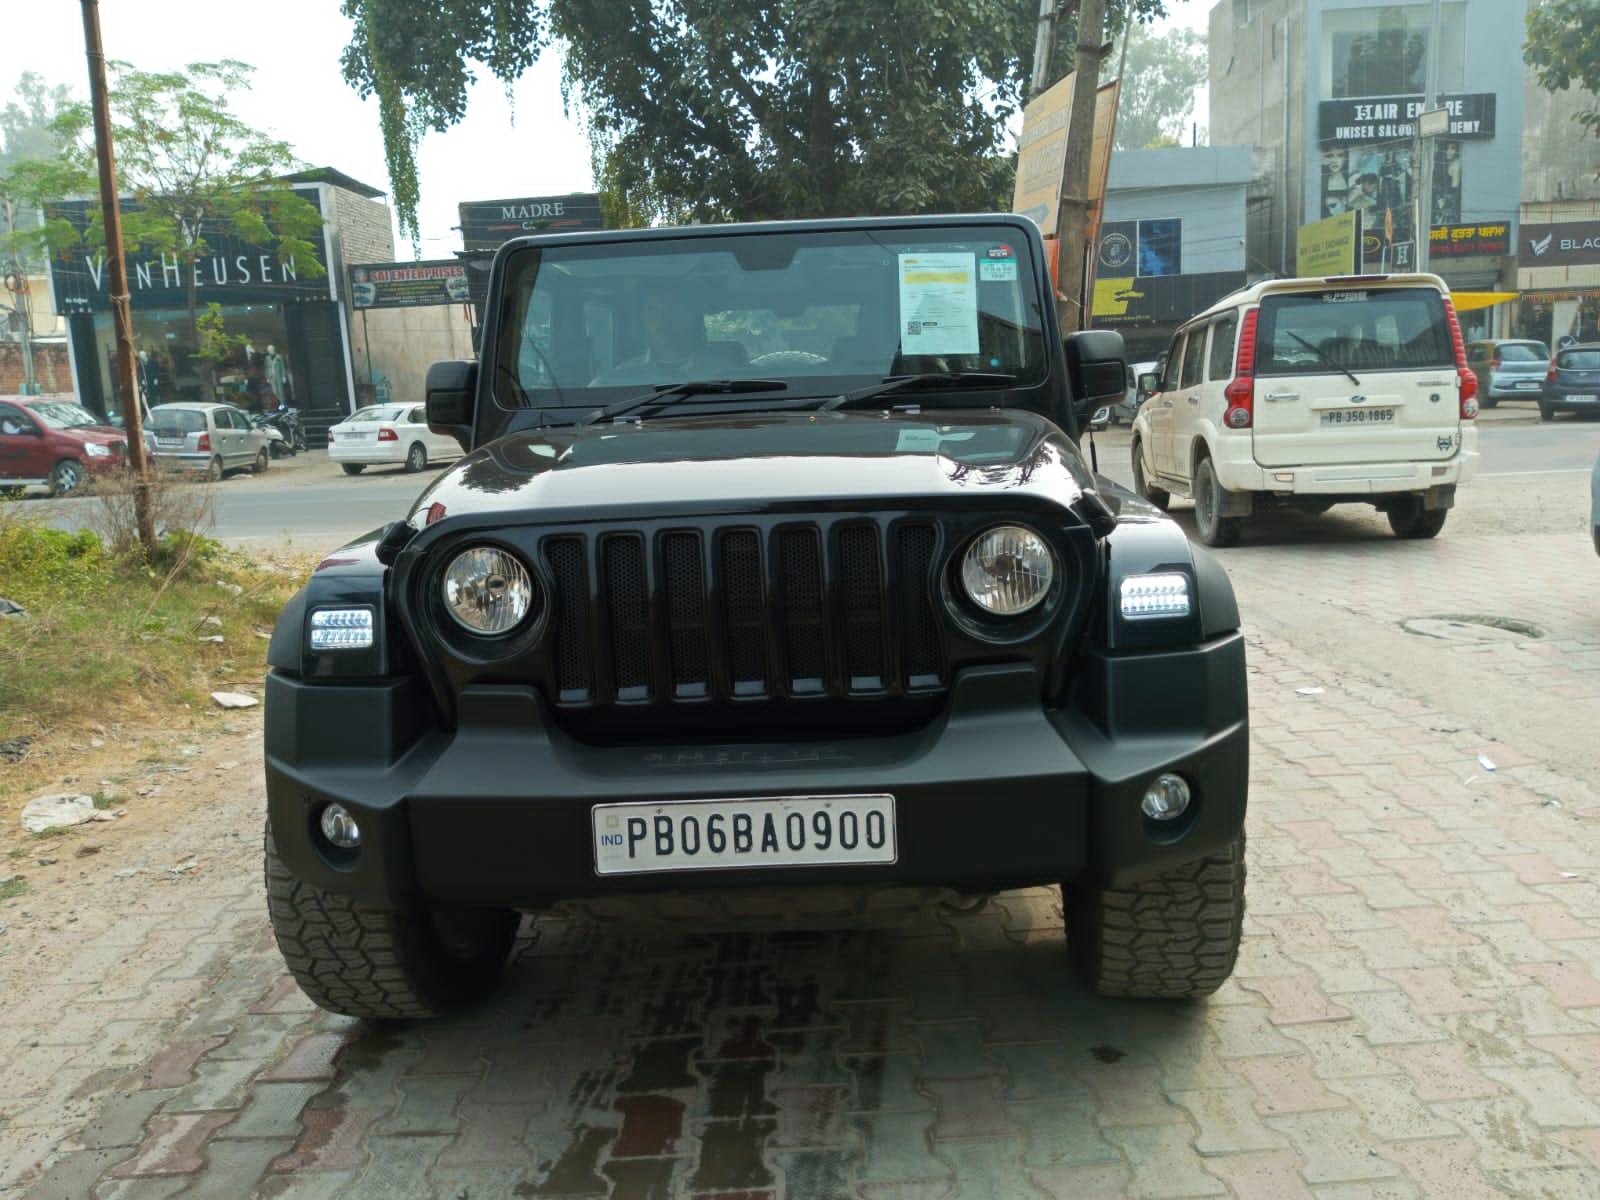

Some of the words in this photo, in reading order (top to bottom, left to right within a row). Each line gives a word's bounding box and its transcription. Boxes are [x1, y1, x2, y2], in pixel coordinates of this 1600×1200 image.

[1336, 125, 1374, 140] UNISEX
[502, 202, 565, 220] MADRE
[391, 265, 464, 282] ENTERPRISES
[601, 833, 623, 847] IND
[627, 810, 886, 858] PB06BA0900
